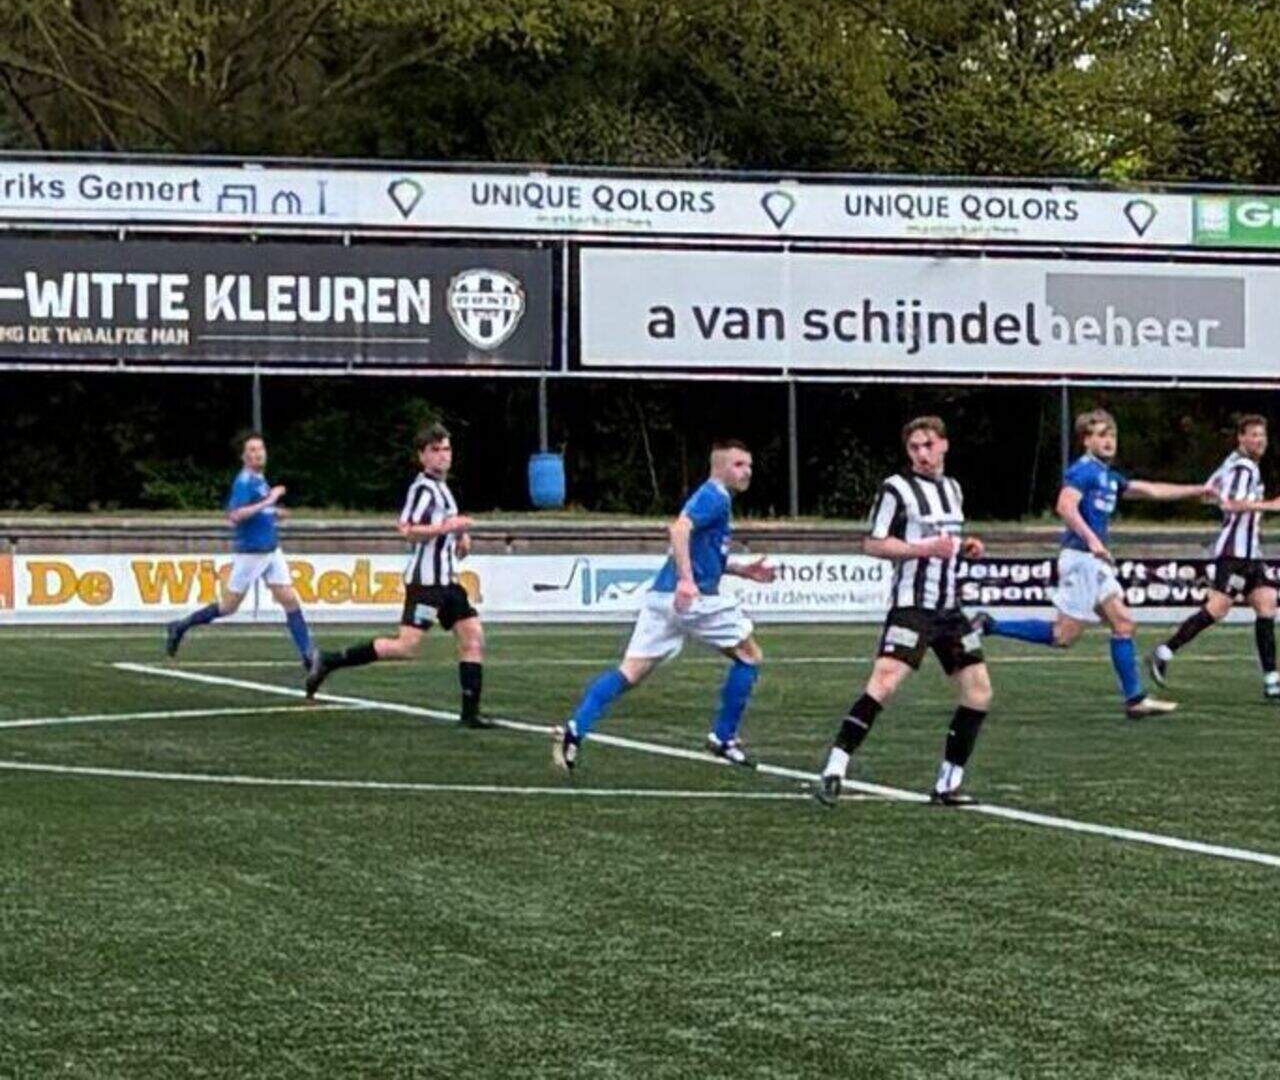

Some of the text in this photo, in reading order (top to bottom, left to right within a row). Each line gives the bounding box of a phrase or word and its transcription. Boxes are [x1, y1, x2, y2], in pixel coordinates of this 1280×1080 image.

[79, 174, 201, 202] Gemert
[471, 182, 715, 213] UNIQUE QOLORS
[845, 193, 1079, 221] UNIQUE QOLORS
[205, 274, 431, 325] KLEUREN
[28, 326, 51, 344] DE
[648, 305, 675, 340] a
[692, 306, 784, 340] van
[26, 560, 114, 606] De
[956, 562, 1050, 583] Jeugd
[1156, 562, 1196, 580] de
